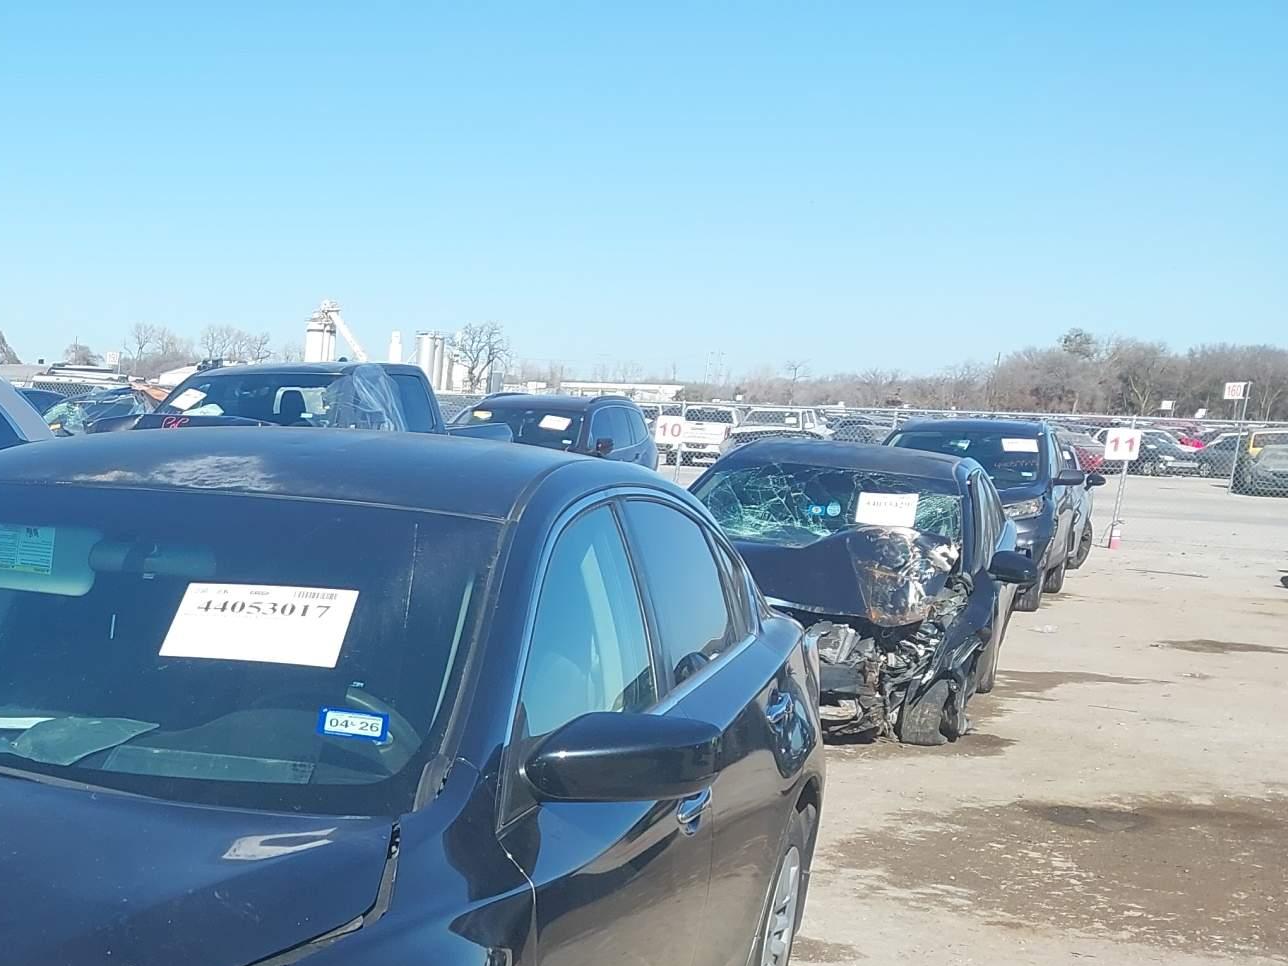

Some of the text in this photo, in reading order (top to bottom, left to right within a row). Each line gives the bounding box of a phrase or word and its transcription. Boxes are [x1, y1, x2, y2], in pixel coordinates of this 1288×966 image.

[659, 423, 682, 438] 10
[1110, 436, 1136, 453] 11
[197, 599, 332, 619] 44053017
[329, 718, 381, 733] 04 26
